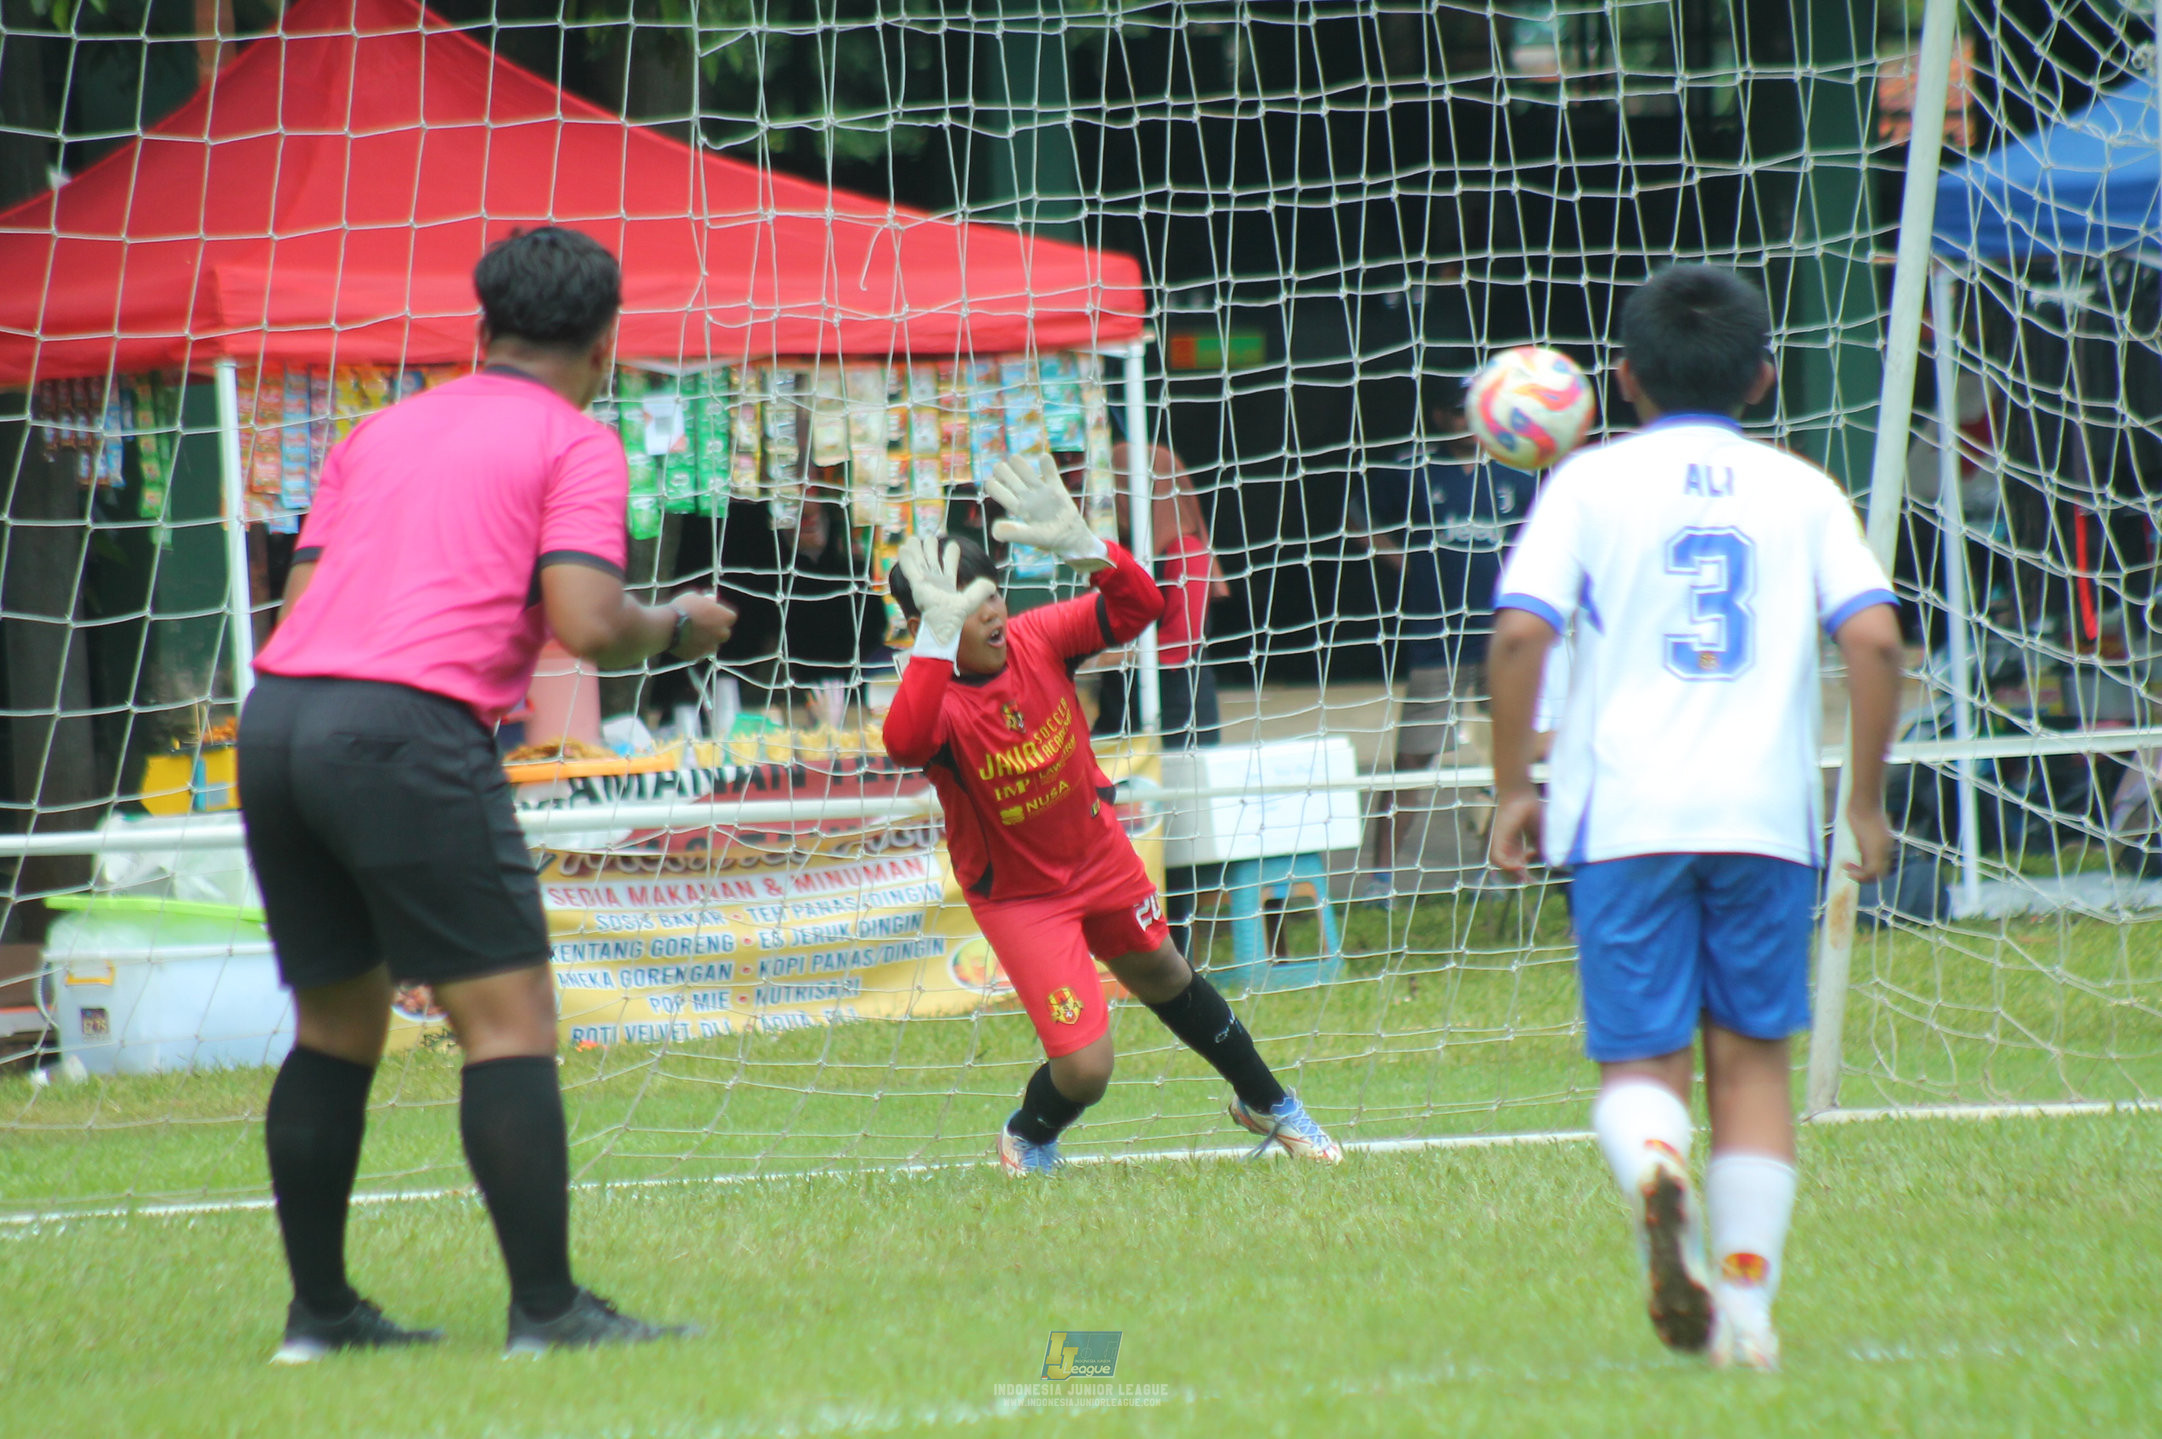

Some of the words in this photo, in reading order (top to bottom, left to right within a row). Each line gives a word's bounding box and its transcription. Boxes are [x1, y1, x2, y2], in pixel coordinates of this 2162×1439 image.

[1684, 463, 1734, 497] ALI
[1663, 525, 1757, 682] 3
[1033, 697, 1068, 744] SOCCER
[547, 886, 622, 908] SEDIA
[628, 878, 756, 907] MAKANAN
[762, 877, 783, 897] &
[791, 857, 926, 892] MINUMAN
[595, 912, 655, 932] SOSIS
[659, 909, 728, 928] BAKAR
[746, 904, 787, 923] TEH
[651, 934, 735, 959] GORENG
[758, 930, 785, 950] ES
[790, 923, 851, 947] JERUK
[858, 912, 924, 939] DINGIN
[619, 963, 733, 988] GORENGAN
[759, 955, 805, 977] KOPI
[811, 937, 945, 973] PANAS/DINGIN
[648, 996, 686, 1014] POP
[692, 990, 731, 1012] MIE
